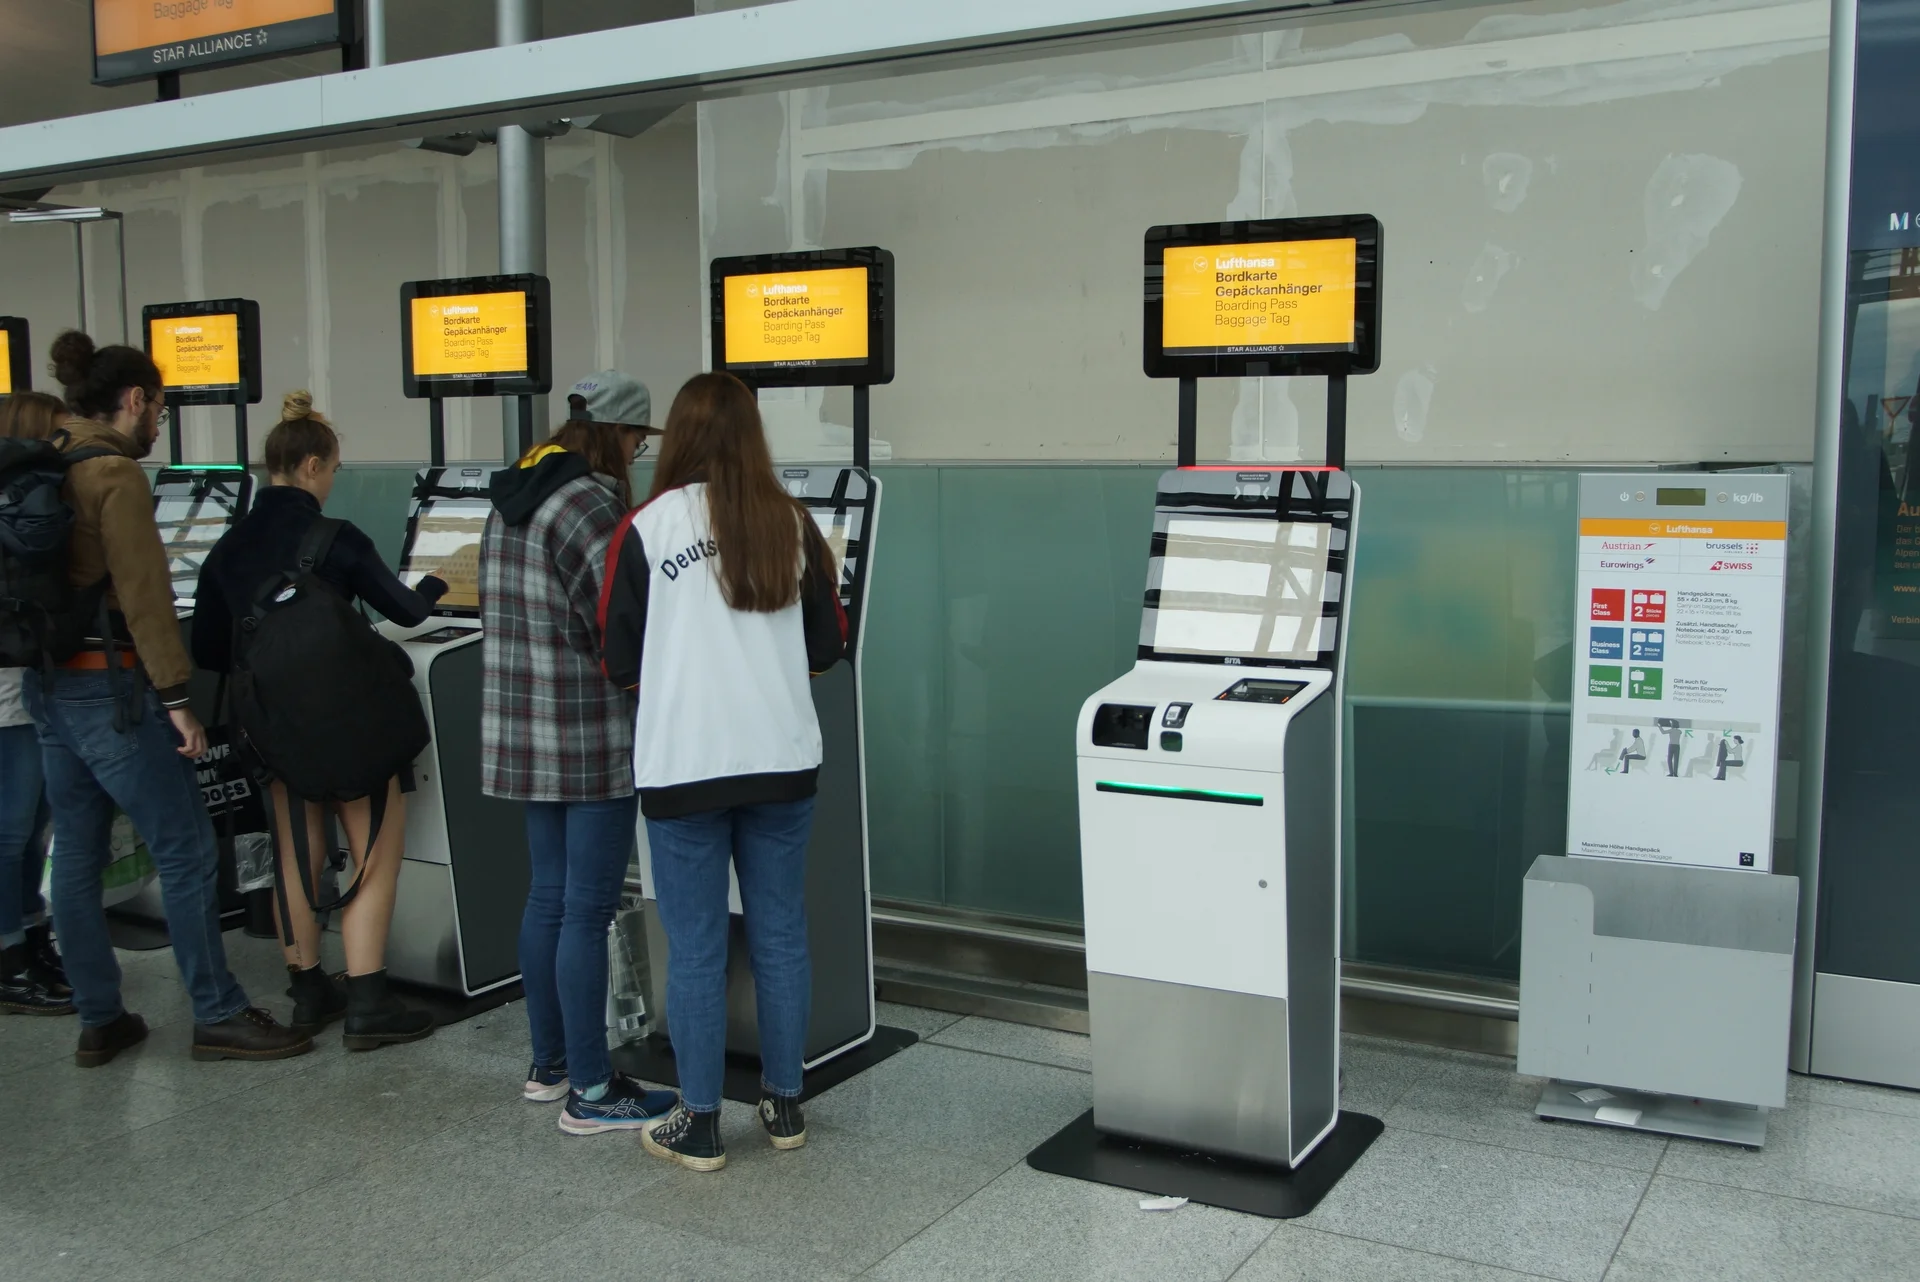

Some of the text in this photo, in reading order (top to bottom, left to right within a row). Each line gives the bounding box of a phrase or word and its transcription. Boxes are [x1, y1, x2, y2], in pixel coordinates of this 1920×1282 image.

[154, 0, 208, 20] Baggage
[153, 34, 252, 64] STAR ALLIANCE
[1216, 256, 1275, 270] Lufthansa
[1216, 270, 1278, 283] Bordkarte
[763, 284, 808, 295] Lufthansa
[1216, 283, 1322, 298] Gepäckanhänger
[763, 296, 810, 306] Bordkarte
[1216, 298, 1298, 312] Boarding Pass
[443, 306, 478, 316] Lufthansa
[763, 307, 844, 320] Gepäckanhänger
[444, 316, 480, 326] Bordkarte
[1216, 312, 1290, 328] Baggage Tag
[763, 319, 826, 333] Boarding Pass
[444, 326, 508, 338] Gepäckanhänger
[444, 337, 494, 348] Boarding Pass
[764, 332, 820, 345] Baggage Tag
[444, 348, 490, 359] Baggage Tag
[1732, 492, 1764, 504] kg/lb
[1666, 524, 1714, 534] Lufthansa
[1601, 541, 1642, 550] Austrian
[1706, 542, 1743, 550] brussels
[1895, 548, 1919, 558] Alpen
[660, 538, 718, 582] Deuts
[1600, 560, 1644, 571] Eurowings
[1723, 562, 1753, 570] SWISS
[1634, 606, 1643, 617] 2
[1633, 645, 1642, 656] 2
[1590, 679, 1620, 687] Economy
[1633, 683, 1639, 694] 1
